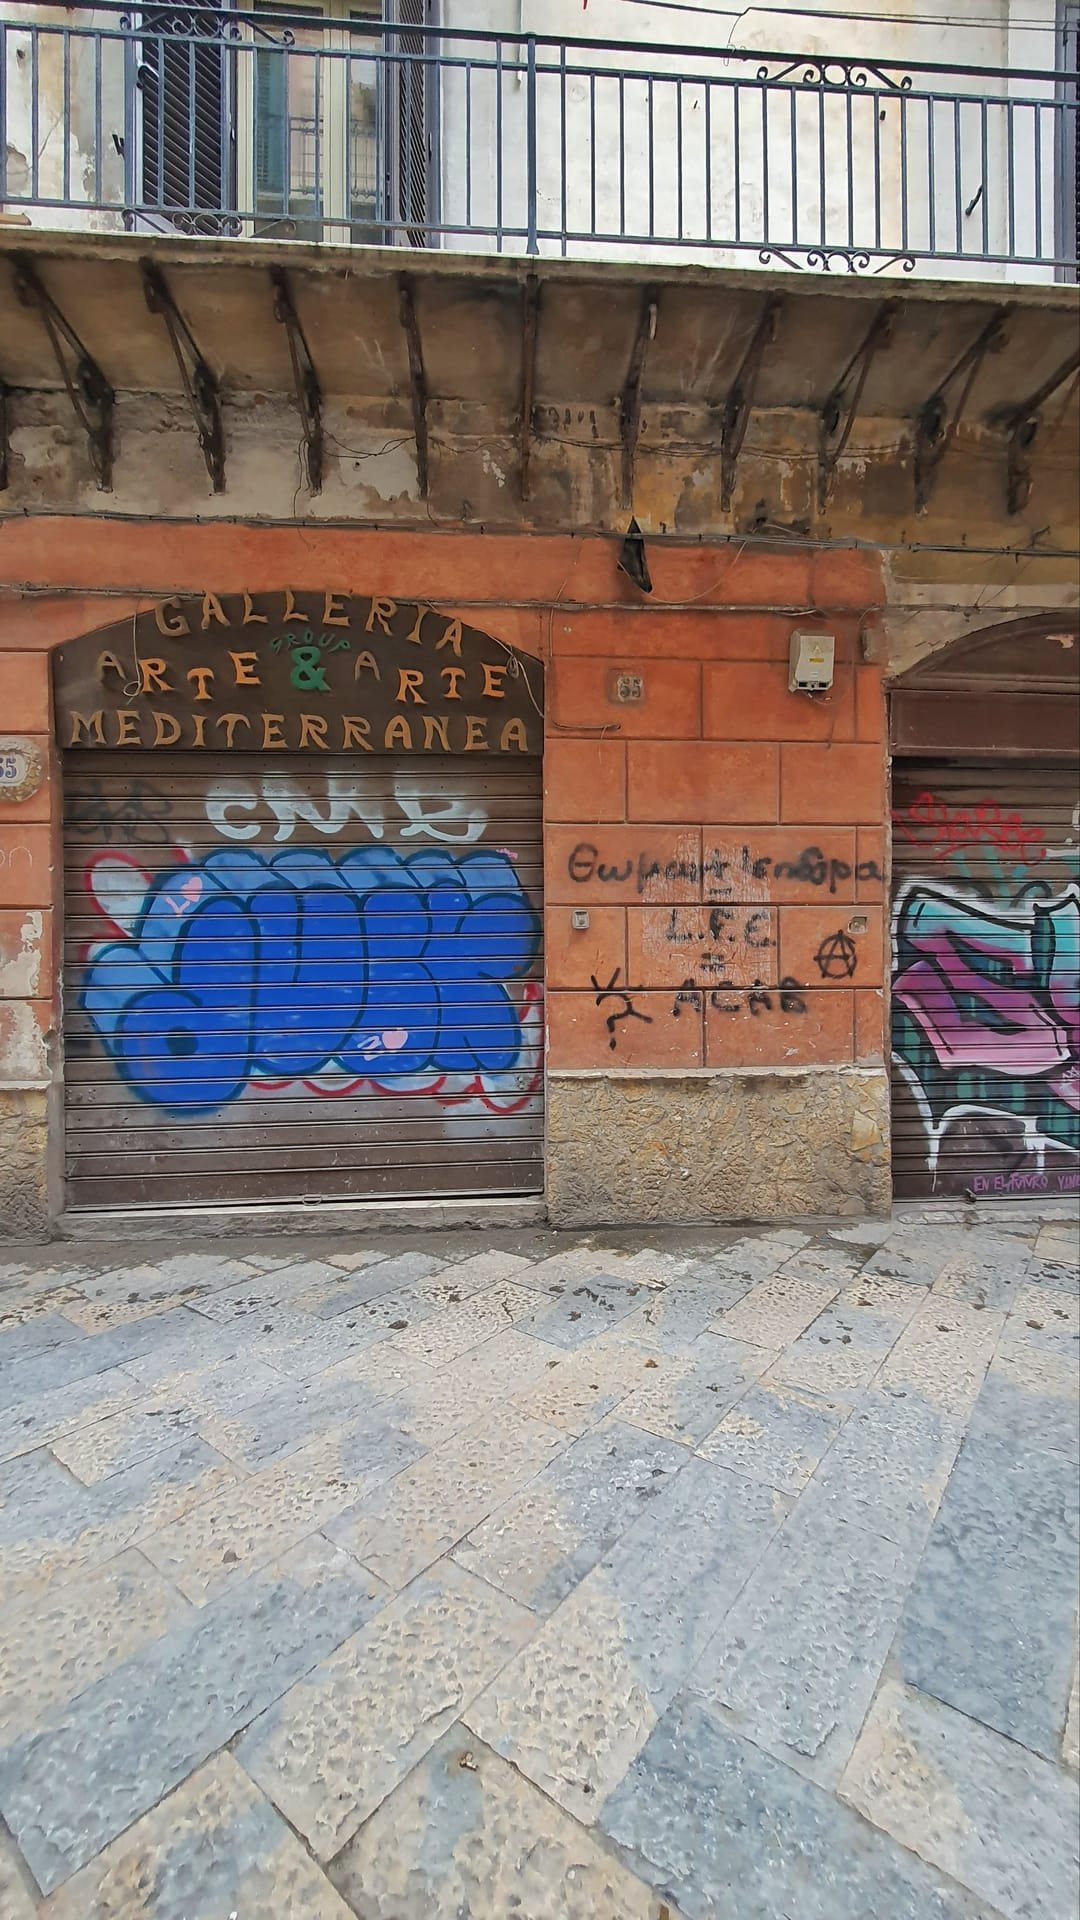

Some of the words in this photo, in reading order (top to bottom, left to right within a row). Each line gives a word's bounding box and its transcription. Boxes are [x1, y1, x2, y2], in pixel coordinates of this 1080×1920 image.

[155, 588, 462, 657] GALLERIA
[99, 650, 262, 701] ARTE
[353, 650, 508, 705] ARTE
[70, 709, 528, 752] MEDITERRANEA
